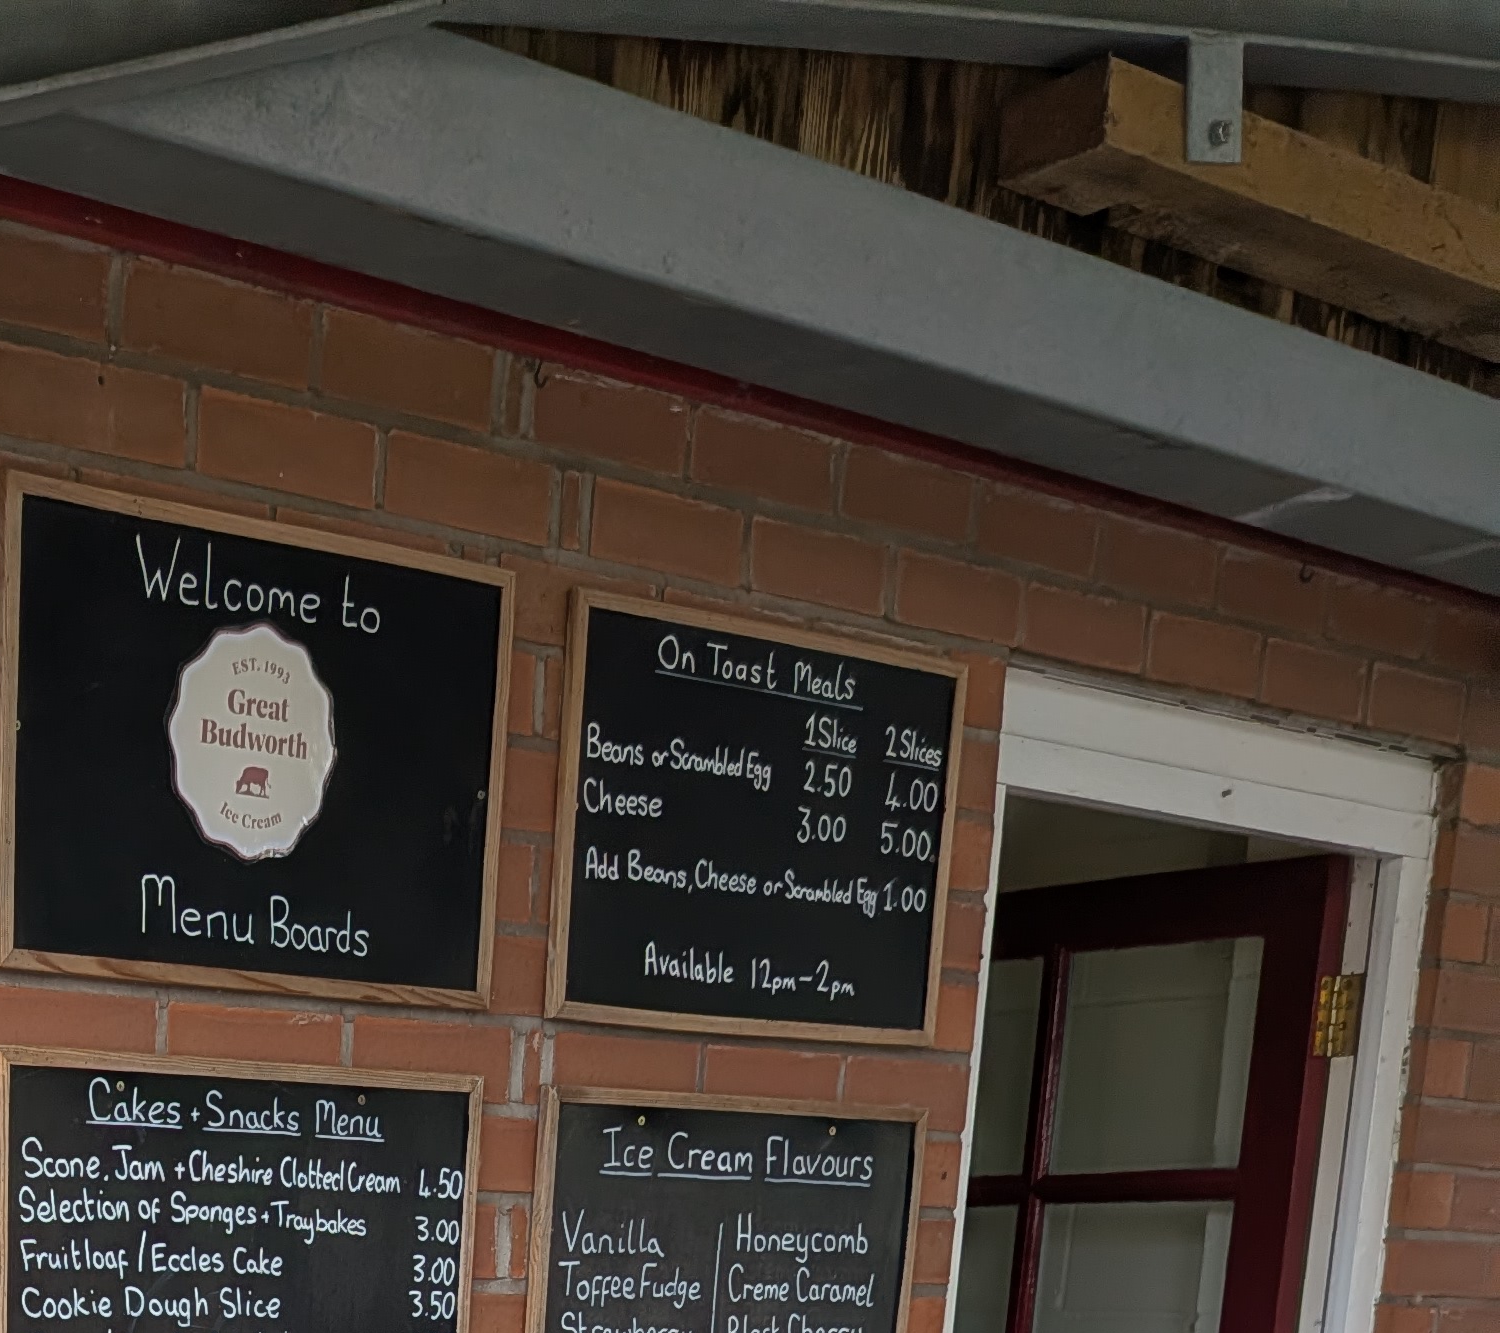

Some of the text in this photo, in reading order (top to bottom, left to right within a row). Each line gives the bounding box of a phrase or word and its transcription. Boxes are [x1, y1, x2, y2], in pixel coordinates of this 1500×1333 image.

[135, 527, 381, 634] Welcome to
[231, 657, 292, 685] EST. 1993
[658, 635, 856, 701] On Toast Meals
[200, 688, 307, 760] Great Budworth
[586, 722, 939, 813] Beans or Scrambled Egg 2.50 4.00
[219, 801, 283, 830] Ice Cream
[583, 777, 847, 844] Cheese 3.00
[141, 873, 370, 957] Menu Boards
[644, 940, 734, 984] Available
[87, 1077, 382, 1138] Cakes Snacks Menu
[602, 1125, 873, 1181] Ice Cream Flavours
[562, 1208, 665, 1258] Vanilla
[736, 1212, 869, 1264] Honeycomb
[21, 1285, 456, 1328] Cookie Dough Slice 3.50
